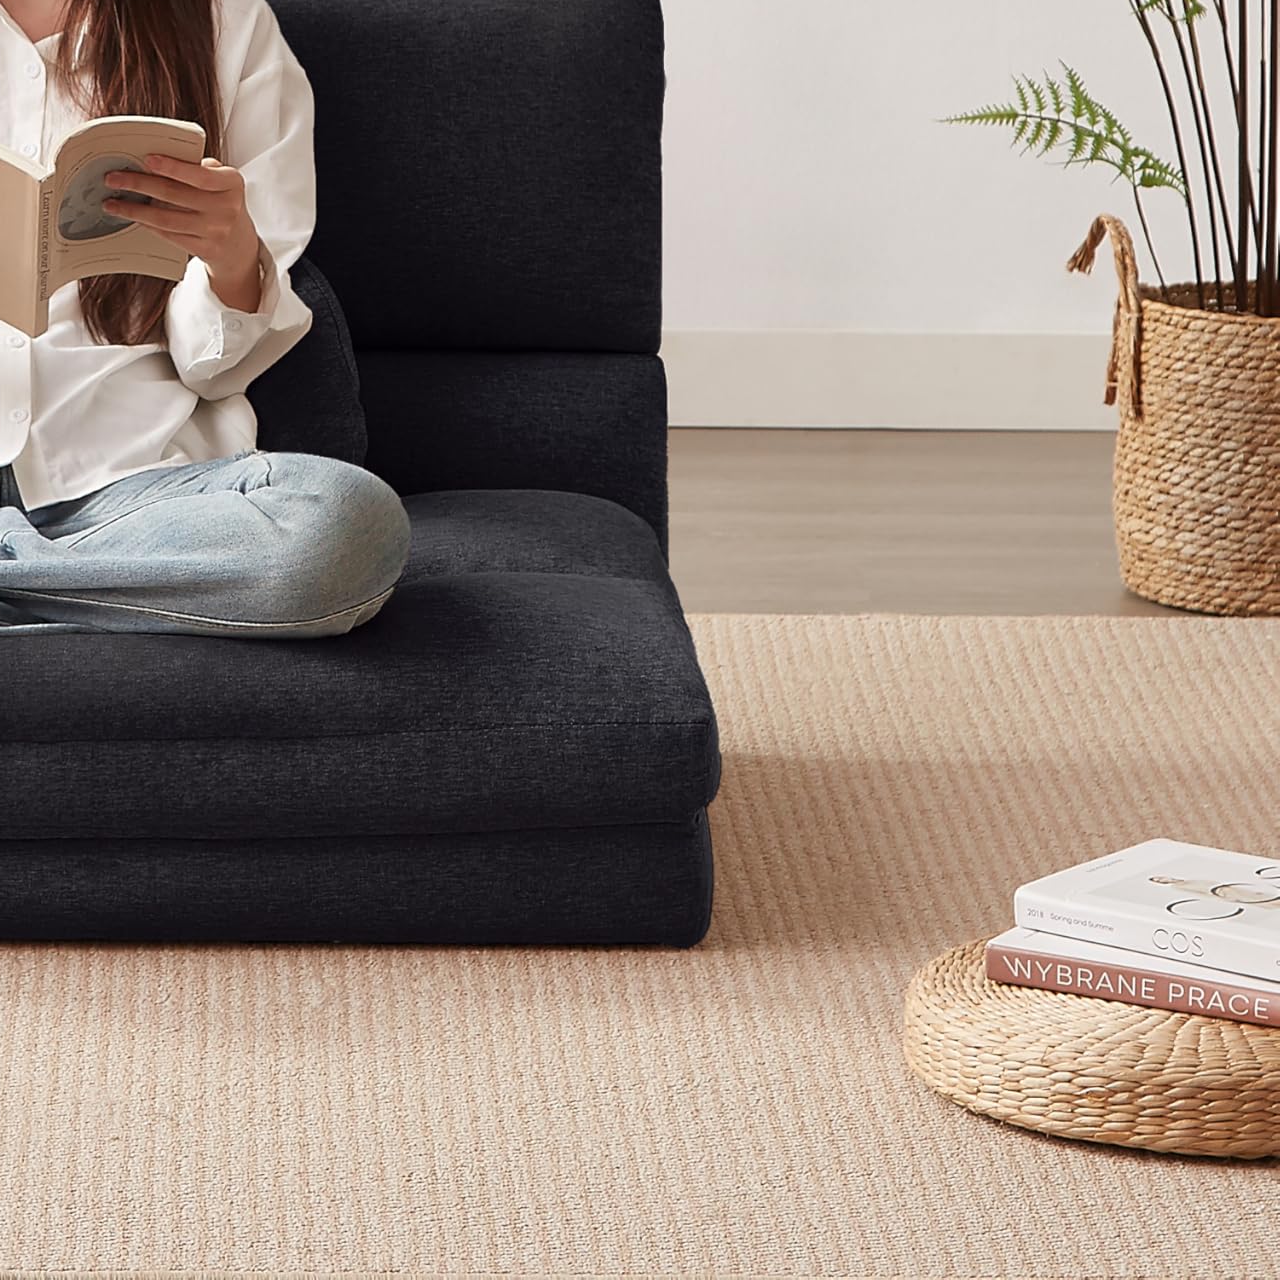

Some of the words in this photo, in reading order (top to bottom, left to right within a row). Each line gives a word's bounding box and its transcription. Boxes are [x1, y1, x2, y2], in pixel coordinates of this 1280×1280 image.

[1152, 928, 1205, 957] COS
[1002, 955, 1156, 1000] WYBRANE
[1168, 982, 1270, 1020] PRACE
